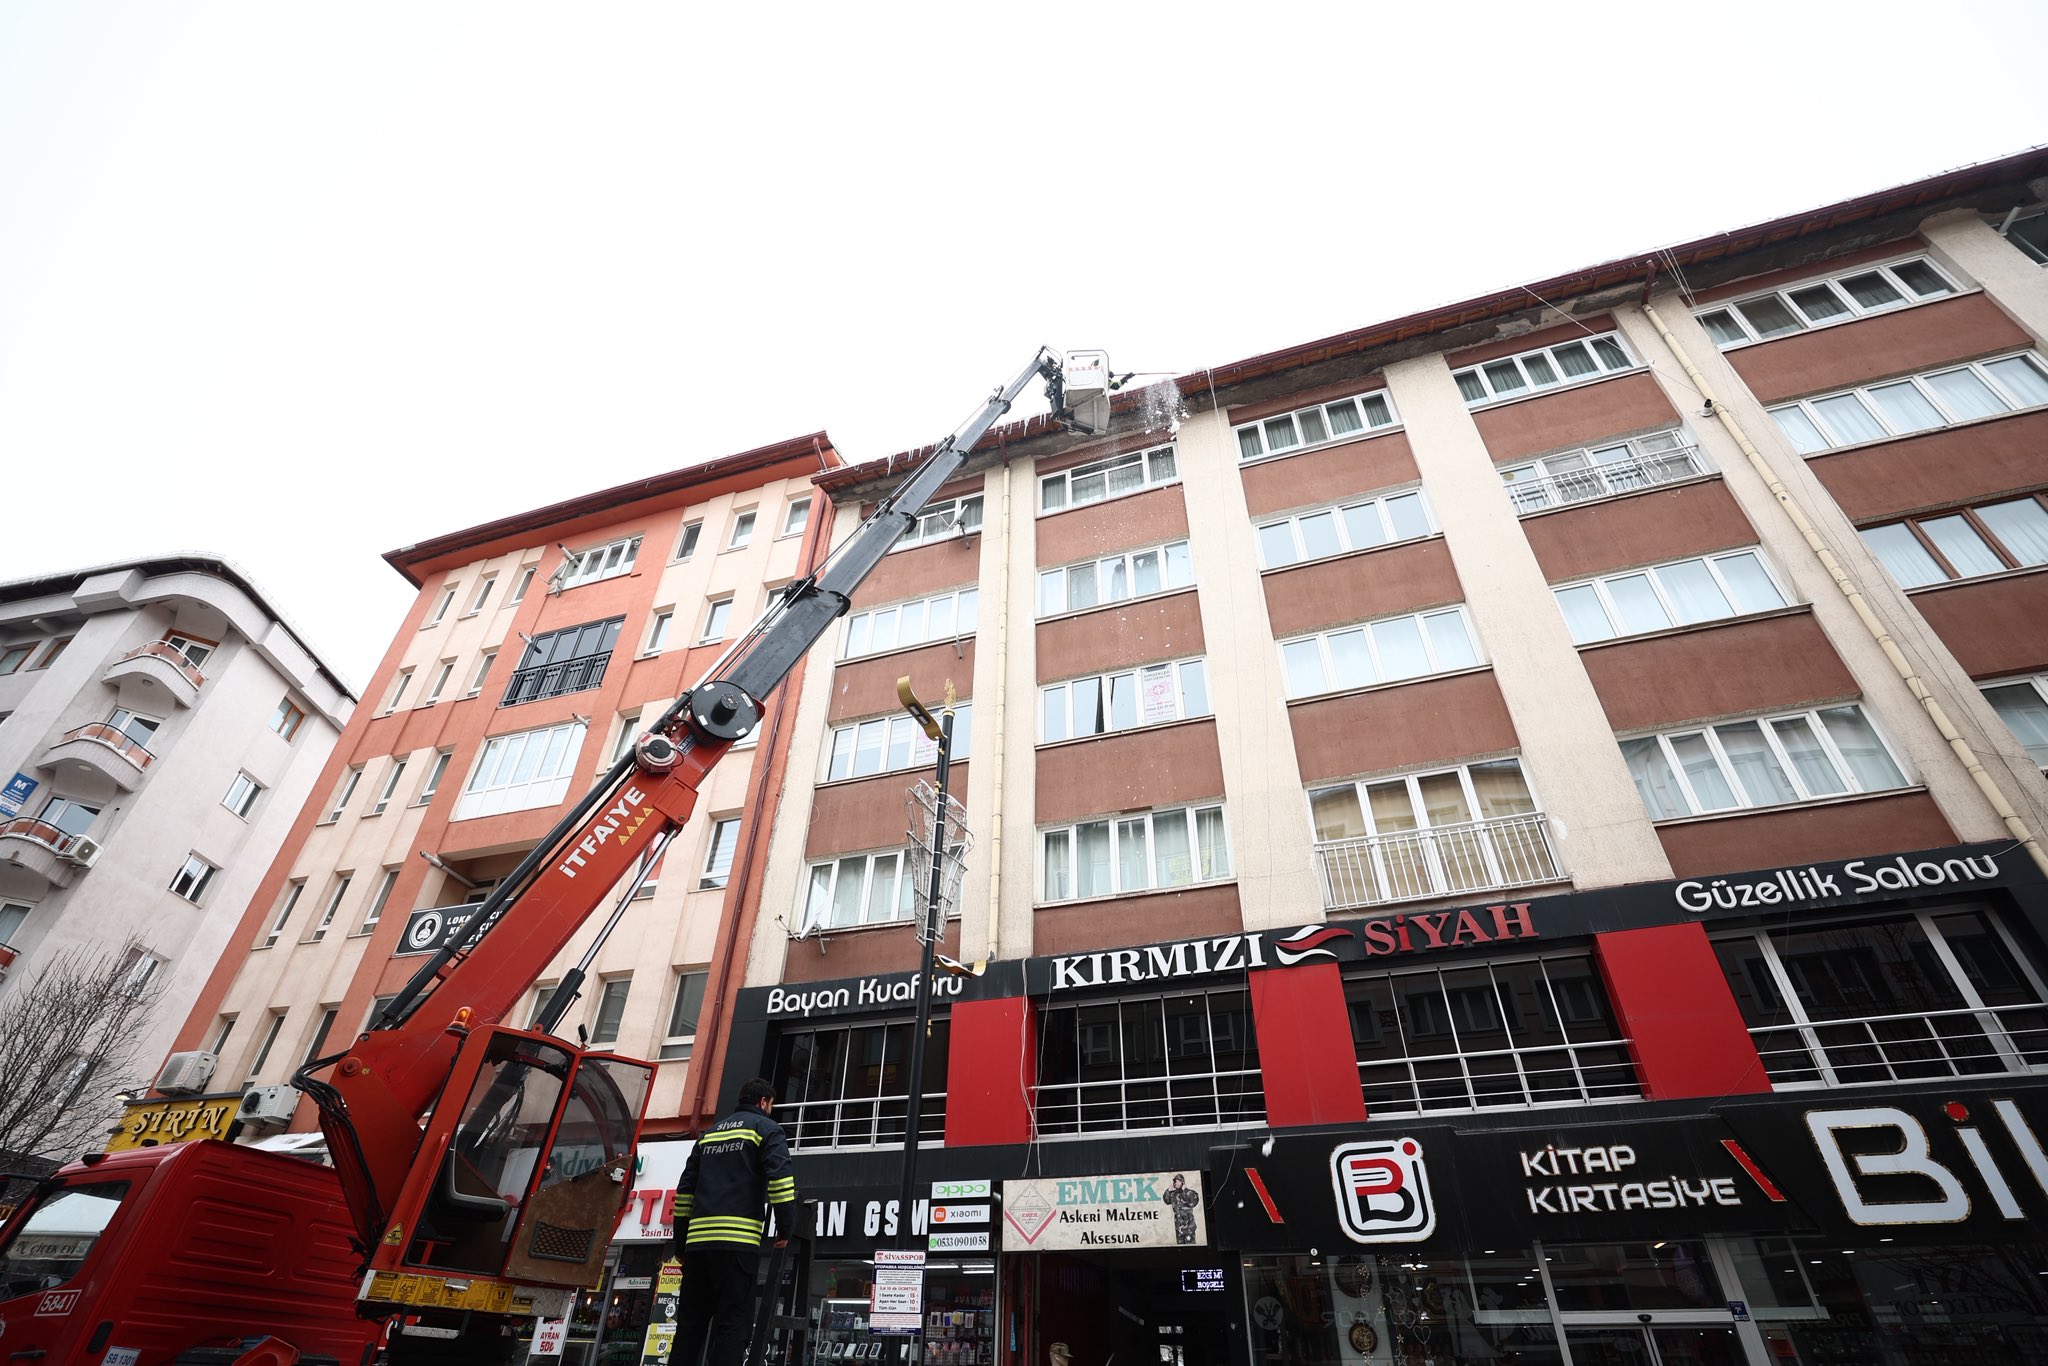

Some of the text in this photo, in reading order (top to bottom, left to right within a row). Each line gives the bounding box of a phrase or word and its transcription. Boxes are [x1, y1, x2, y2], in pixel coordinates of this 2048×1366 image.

[1674, 854, 2000, 914] Güzellik Salonu
[1051, 933, 1268, 990] KIRMIZI
[766, 988, 850, 1017] Bayan
[130, 1101, 227, 1143] ŞİRİN
[716, 1120, 744, 1131] SİVAS
[702, 1140, 745, 1155] İTFAİYESİ
[1519, 1144, 1636, 1178] KİTAP
[935, 1184, 987, 1197] oppo
[1056, 1176, 1162, 1206] EMEK
[1525, 1175, 1743, 1215] KIRTASİYE
[641, 1228, 674, 1238] Yasin Us
[884, 1253, 924, 1261] SİVASSPOR
[40, 1294, 76, 1312] 5841
[540, 1332, 560, 1340] AYRAN
